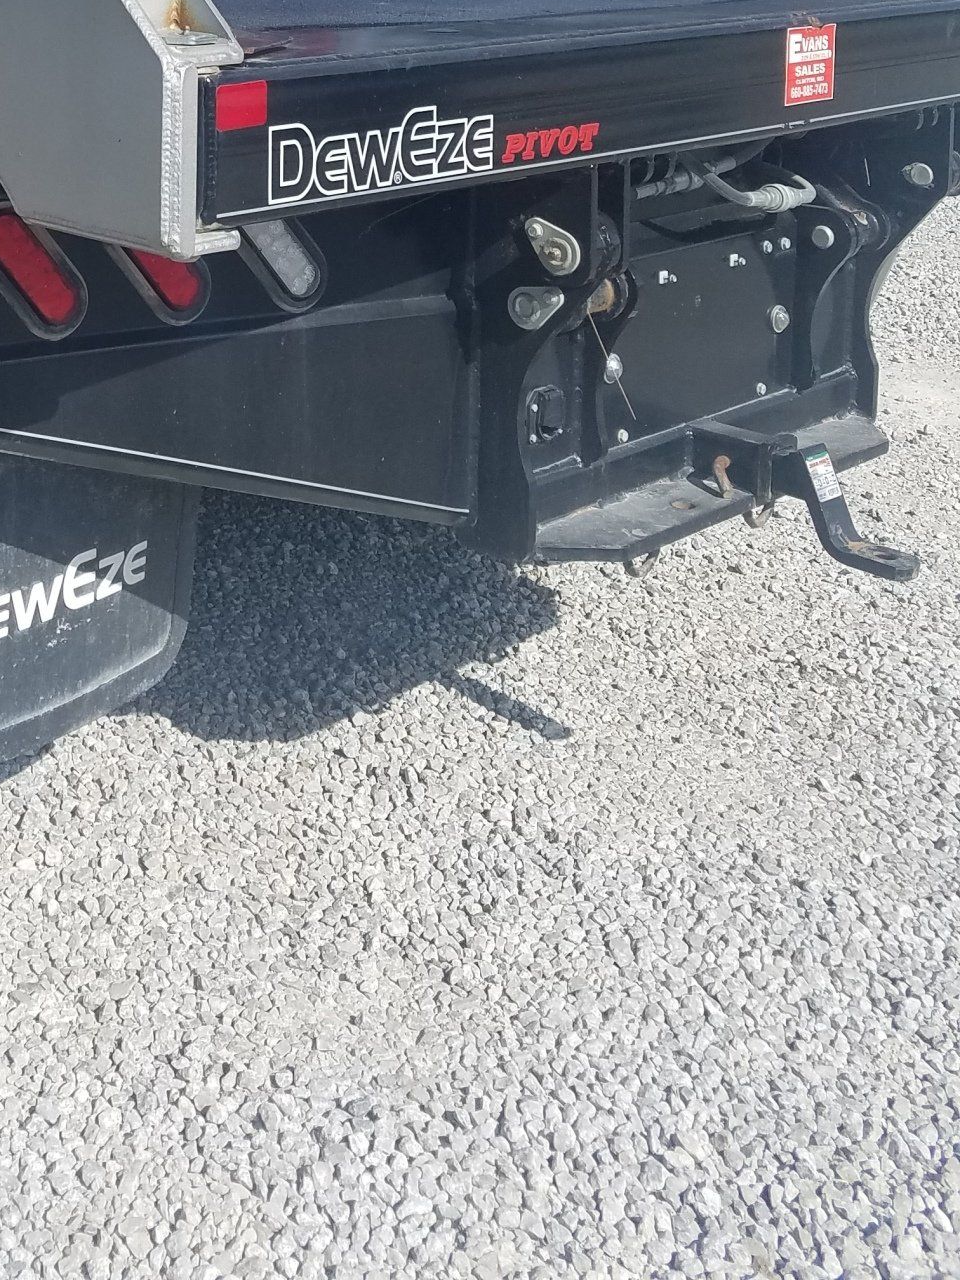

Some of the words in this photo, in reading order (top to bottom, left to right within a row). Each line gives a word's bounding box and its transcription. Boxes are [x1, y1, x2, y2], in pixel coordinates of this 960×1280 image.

[789, 33, 829, 60] EVANS
[795, 63, 826, 77] SALES
[501, 121, 600, 164] PIVOT
